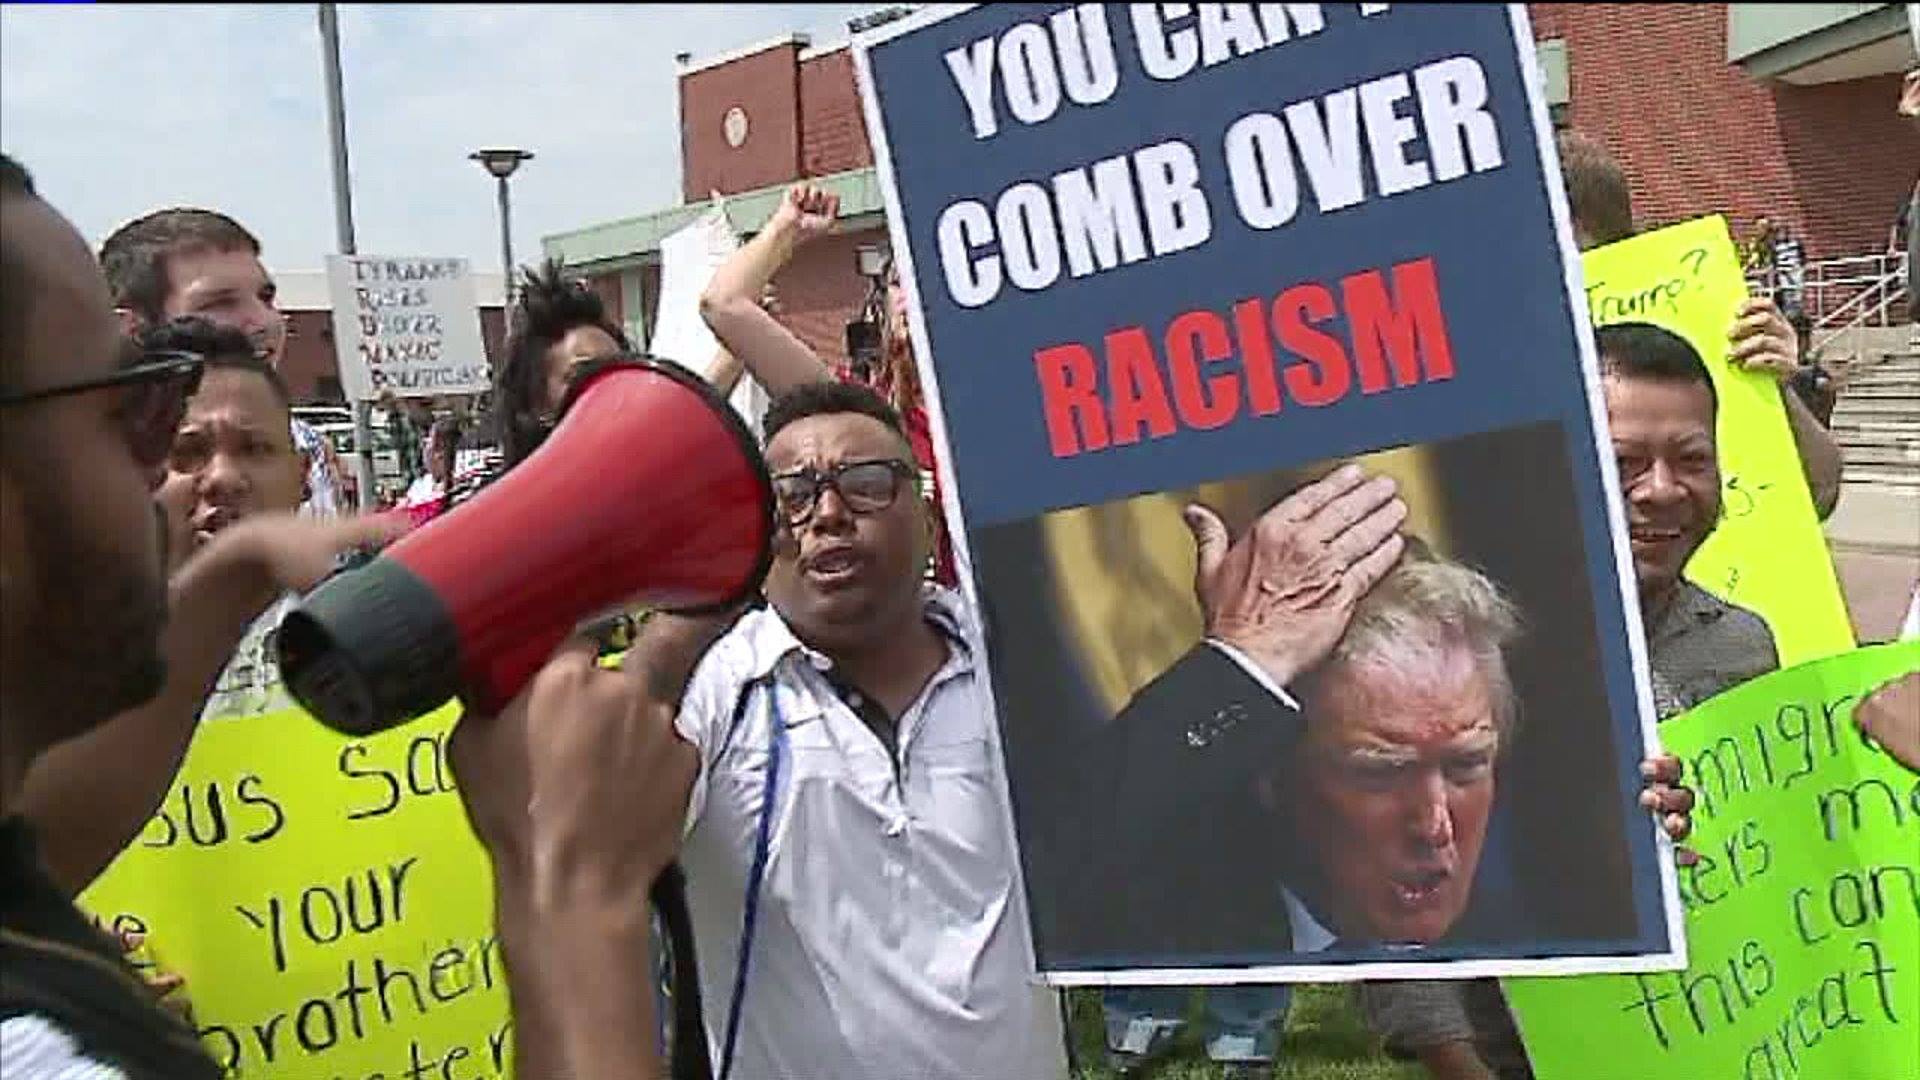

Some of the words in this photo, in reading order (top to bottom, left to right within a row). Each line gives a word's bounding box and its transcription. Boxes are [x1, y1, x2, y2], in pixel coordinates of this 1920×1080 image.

[944, 4, 1121, 140] YOU
[936, 138, 1213, 310] COMB
[1224, 55, 1504, 231] OVER
[1034, 255, 1456, 459] RACISM
